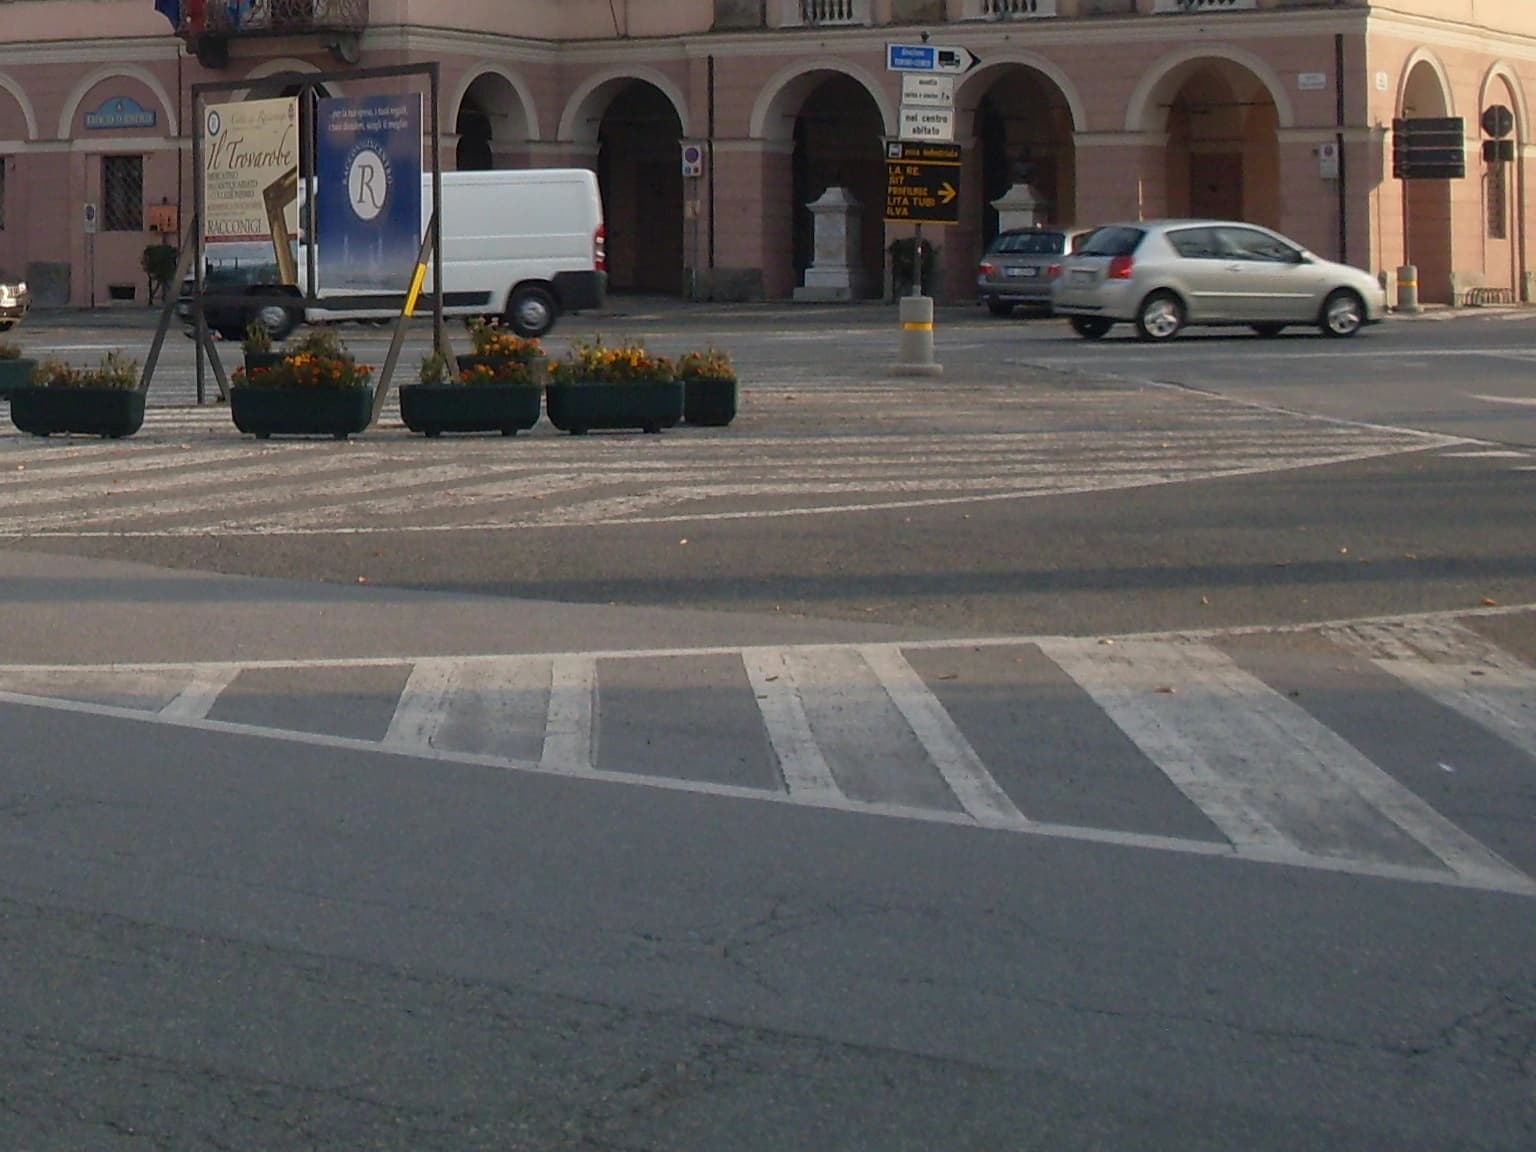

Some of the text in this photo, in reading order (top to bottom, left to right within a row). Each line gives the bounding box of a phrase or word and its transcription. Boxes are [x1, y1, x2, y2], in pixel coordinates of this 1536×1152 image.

[905, 113, 948, 123] nel centro
[912, 126, 940, 136] abitato
[207, 218, 261, 234] RACCONIGI
